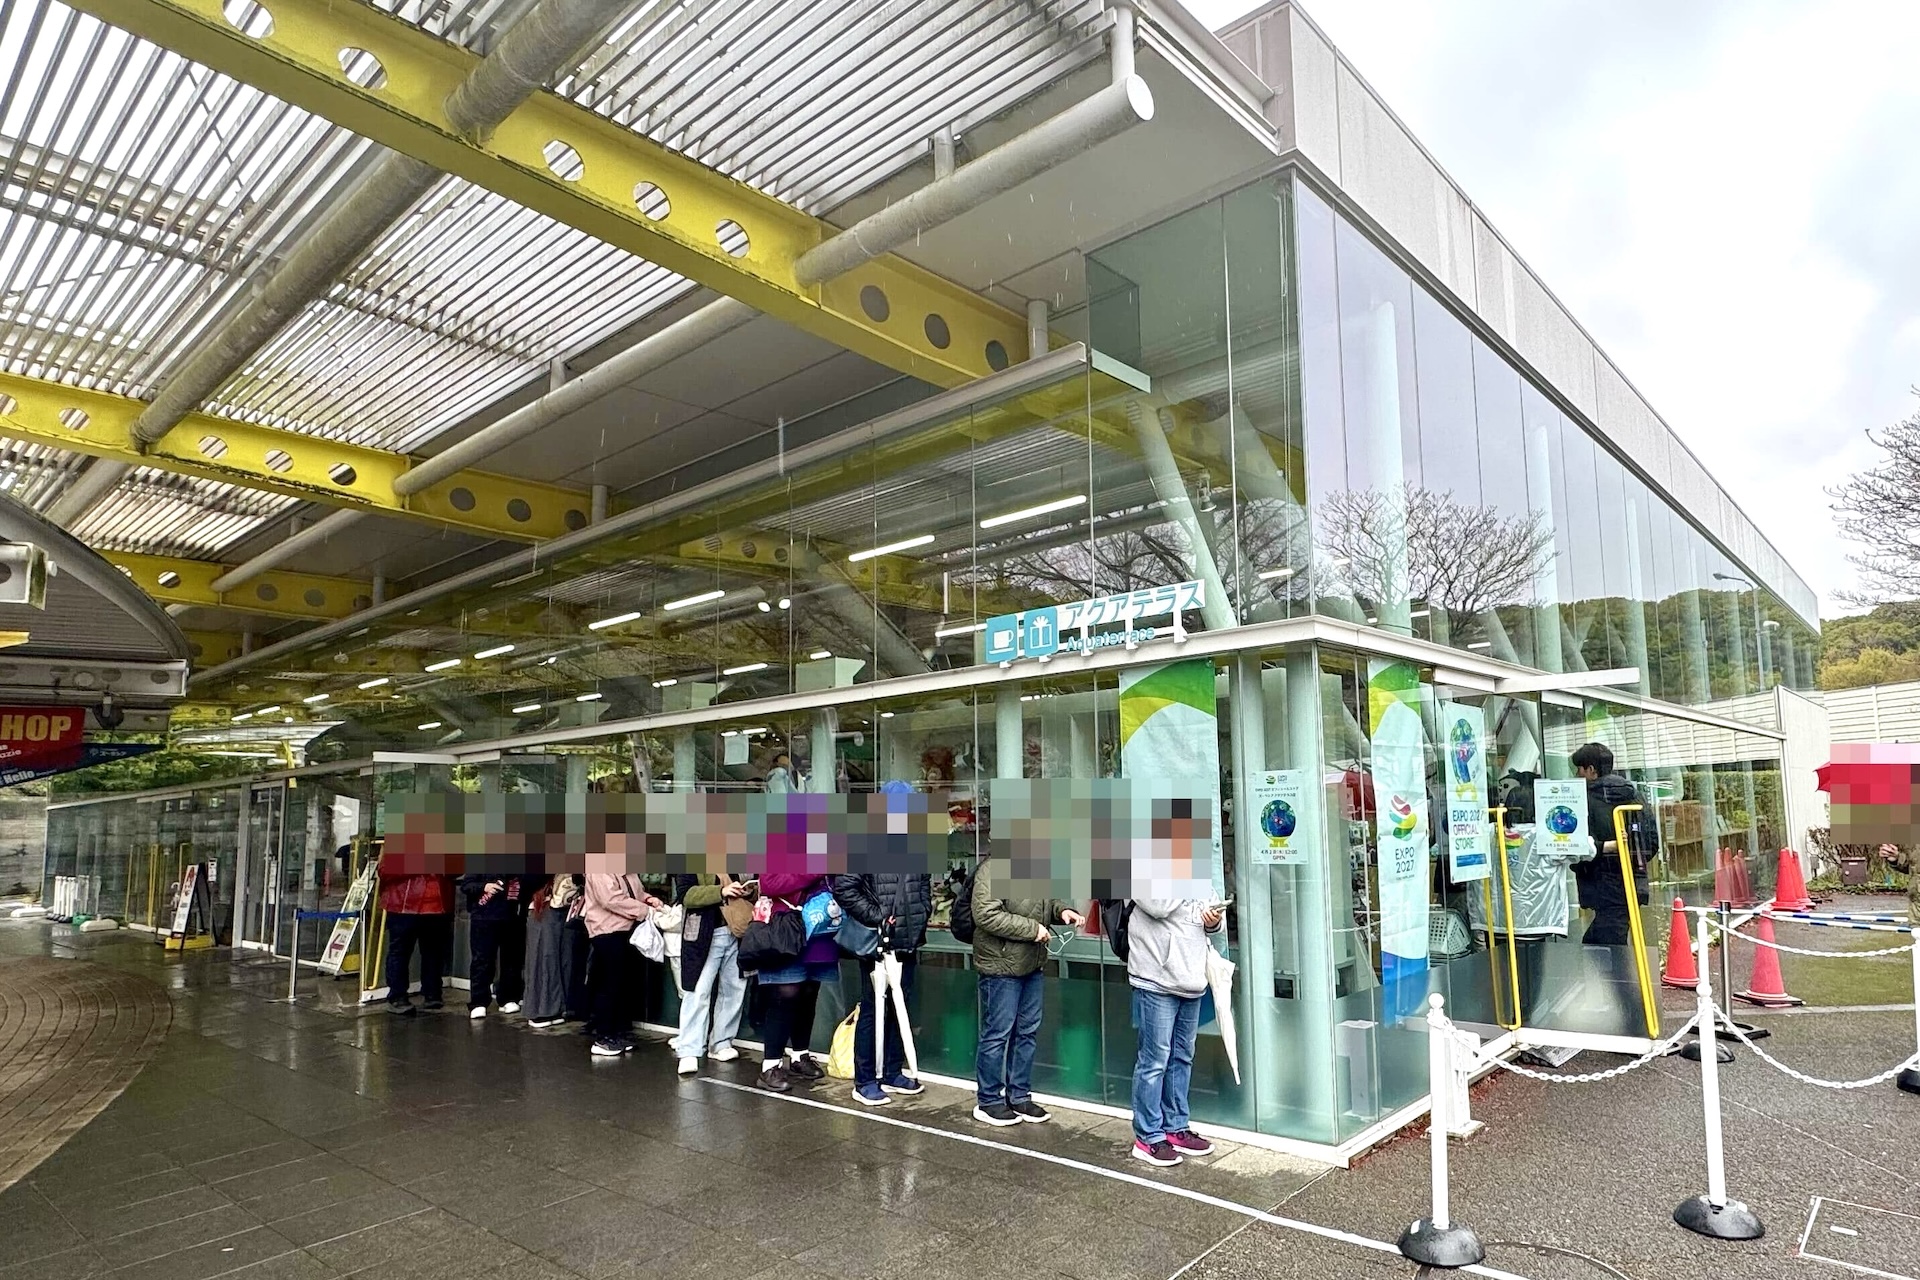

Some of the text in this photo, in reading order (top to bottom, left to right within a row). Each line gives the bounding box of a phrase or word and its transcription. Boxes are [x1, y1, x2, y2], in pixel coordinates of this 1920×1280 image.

[1065, 582, 1204, 628] アクアテラス
[1066, 627, 1155, 654] Aquaterrace
[3, 770, 36, 784] Hello
[1452, 809, 1469, 822] EXPO
[1453, 823, 1479, 836] OFFICIAL
[1455, 837, 1475, 850] STORE
[1395, 846, 1415, 861] EXPO
[1396, 859, 1415, 874] 2027
[809, 912, 824, 925] 50
